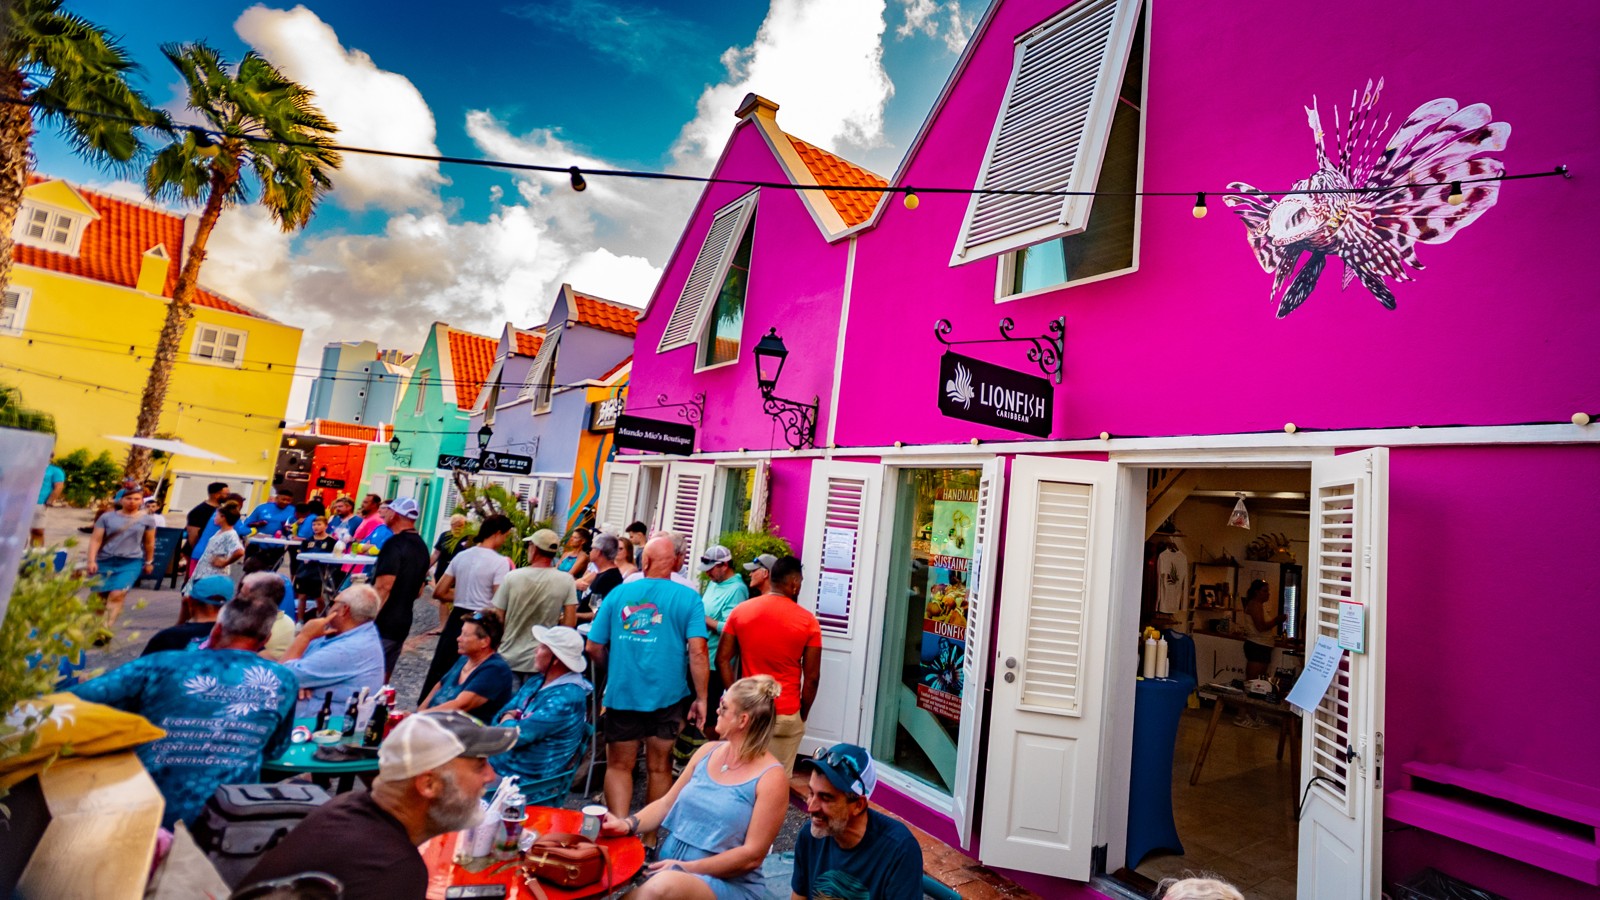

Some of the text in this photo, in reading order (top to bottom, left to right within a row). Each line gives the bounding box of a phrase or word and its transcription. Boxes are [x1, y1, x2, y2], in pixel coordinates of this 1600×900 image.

[980, 382, 1045, 419] LIONFISH
[996, 409, 1030, 423] CARIBBEAN
[618, 427, 692, 446] Mundo Mio's Boutique
[942, 488, 979, 502] HANDMAD
[933, 554, 969, 571] SUSTAINA
[934, 621, 965, 640] LIONFIS
